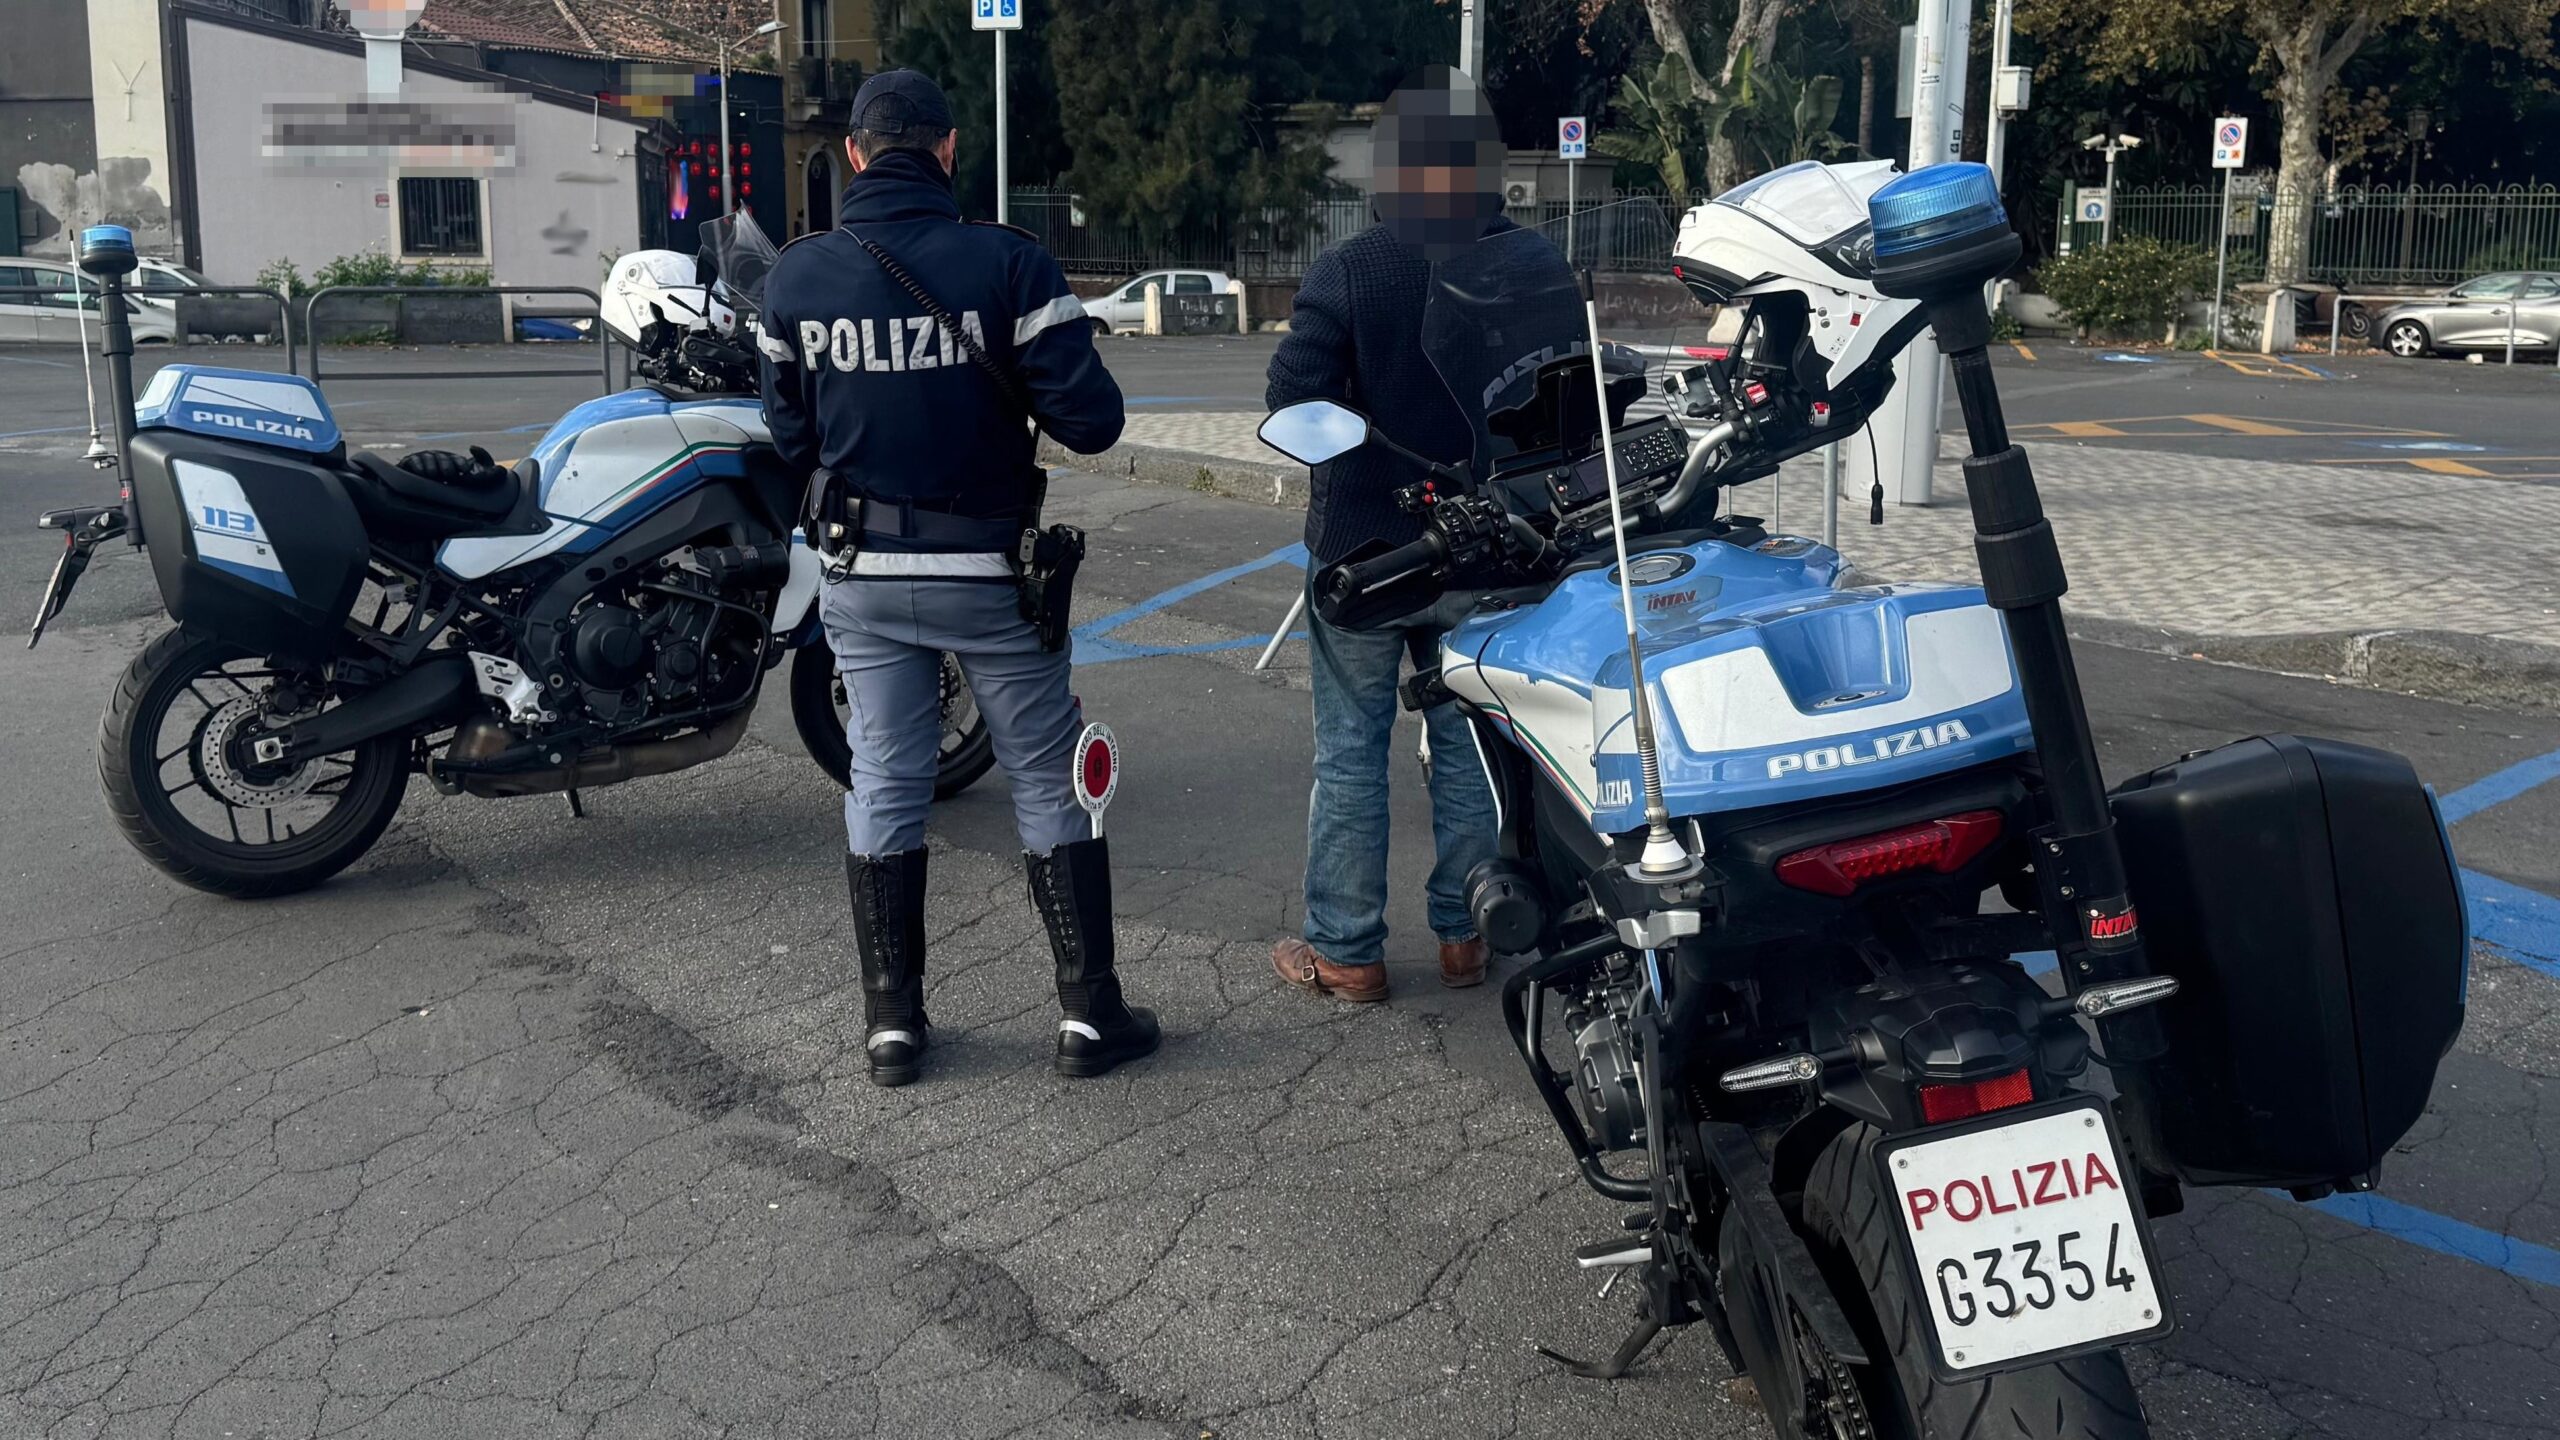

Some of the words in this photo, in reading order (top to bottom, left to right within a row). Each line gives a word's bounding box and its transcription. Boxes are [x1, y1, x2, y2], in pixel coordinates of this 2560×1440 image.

[980, 0, 991, 16] P
[800, 310, 986, 372] POLIZIA
[192, 410, 313, 441] POLIZIA
[203, 506, 255, 533] 113
[1648, 590, 1696, 611] INTAV
[1077, 731, 1092, 784] MINISTERO
[1767, 719, 1970, 779] POLIZIA
[1906, 1152, 2119, 1231] POLIZIA
[1936, 1222, 2136, 1327] G3354
